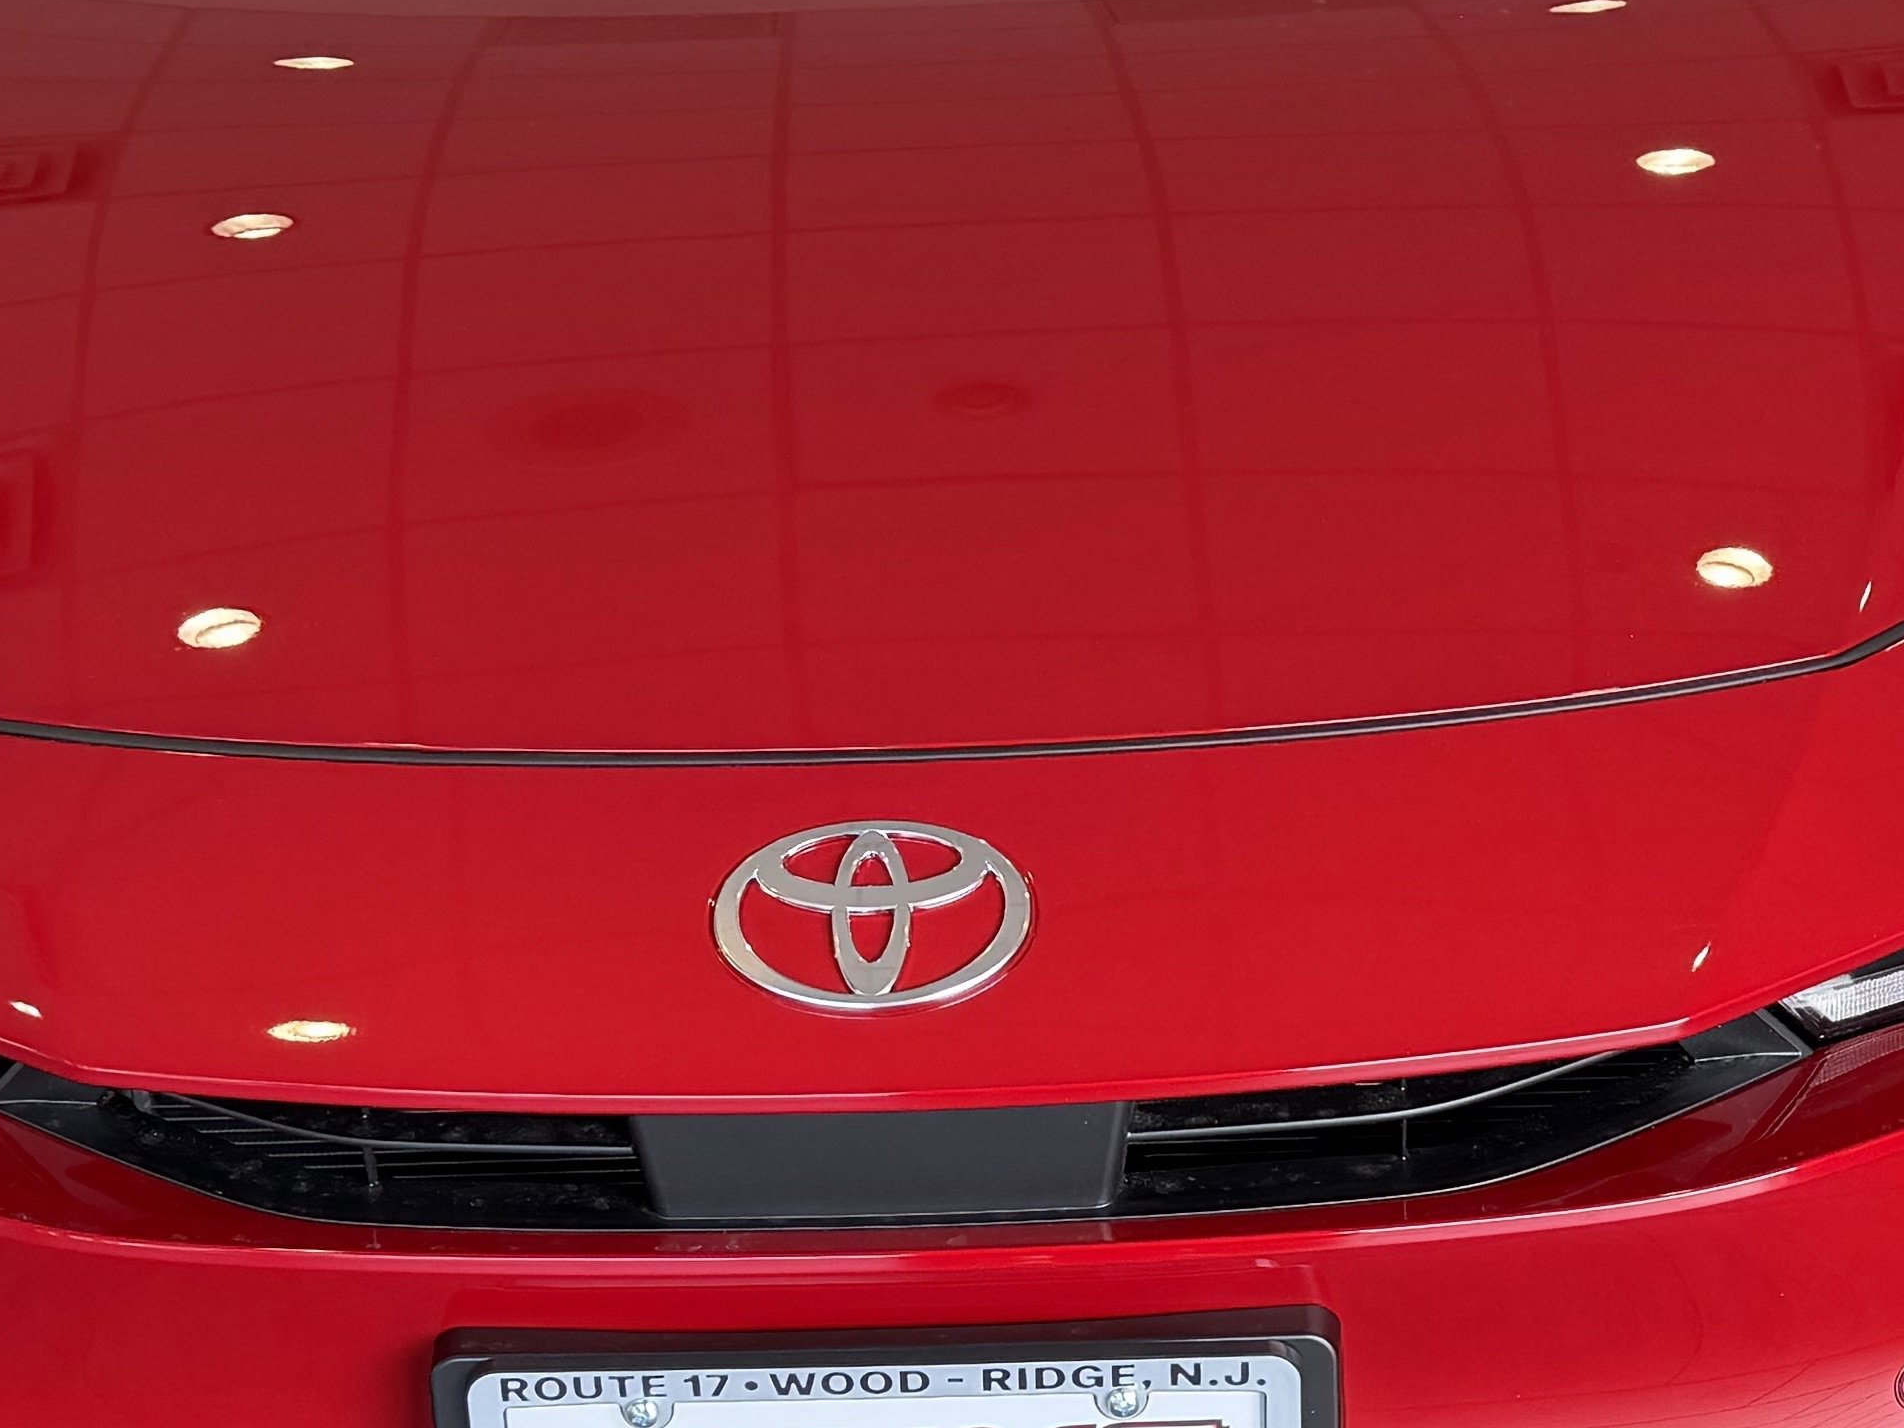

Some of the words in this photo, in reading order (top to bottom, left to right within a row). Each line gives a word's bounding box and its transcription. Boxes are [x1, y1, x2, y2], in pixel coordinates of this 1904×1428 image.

[500, 1375, 667, 1403] ROUTE
[682, 1373, 729, 1398] 17
[769, 1370, 930, 1397] WOOD
[982, 1363, 1152, 1392] RIDGE,
[1170, 1361, 1267, 1387] N.J.
